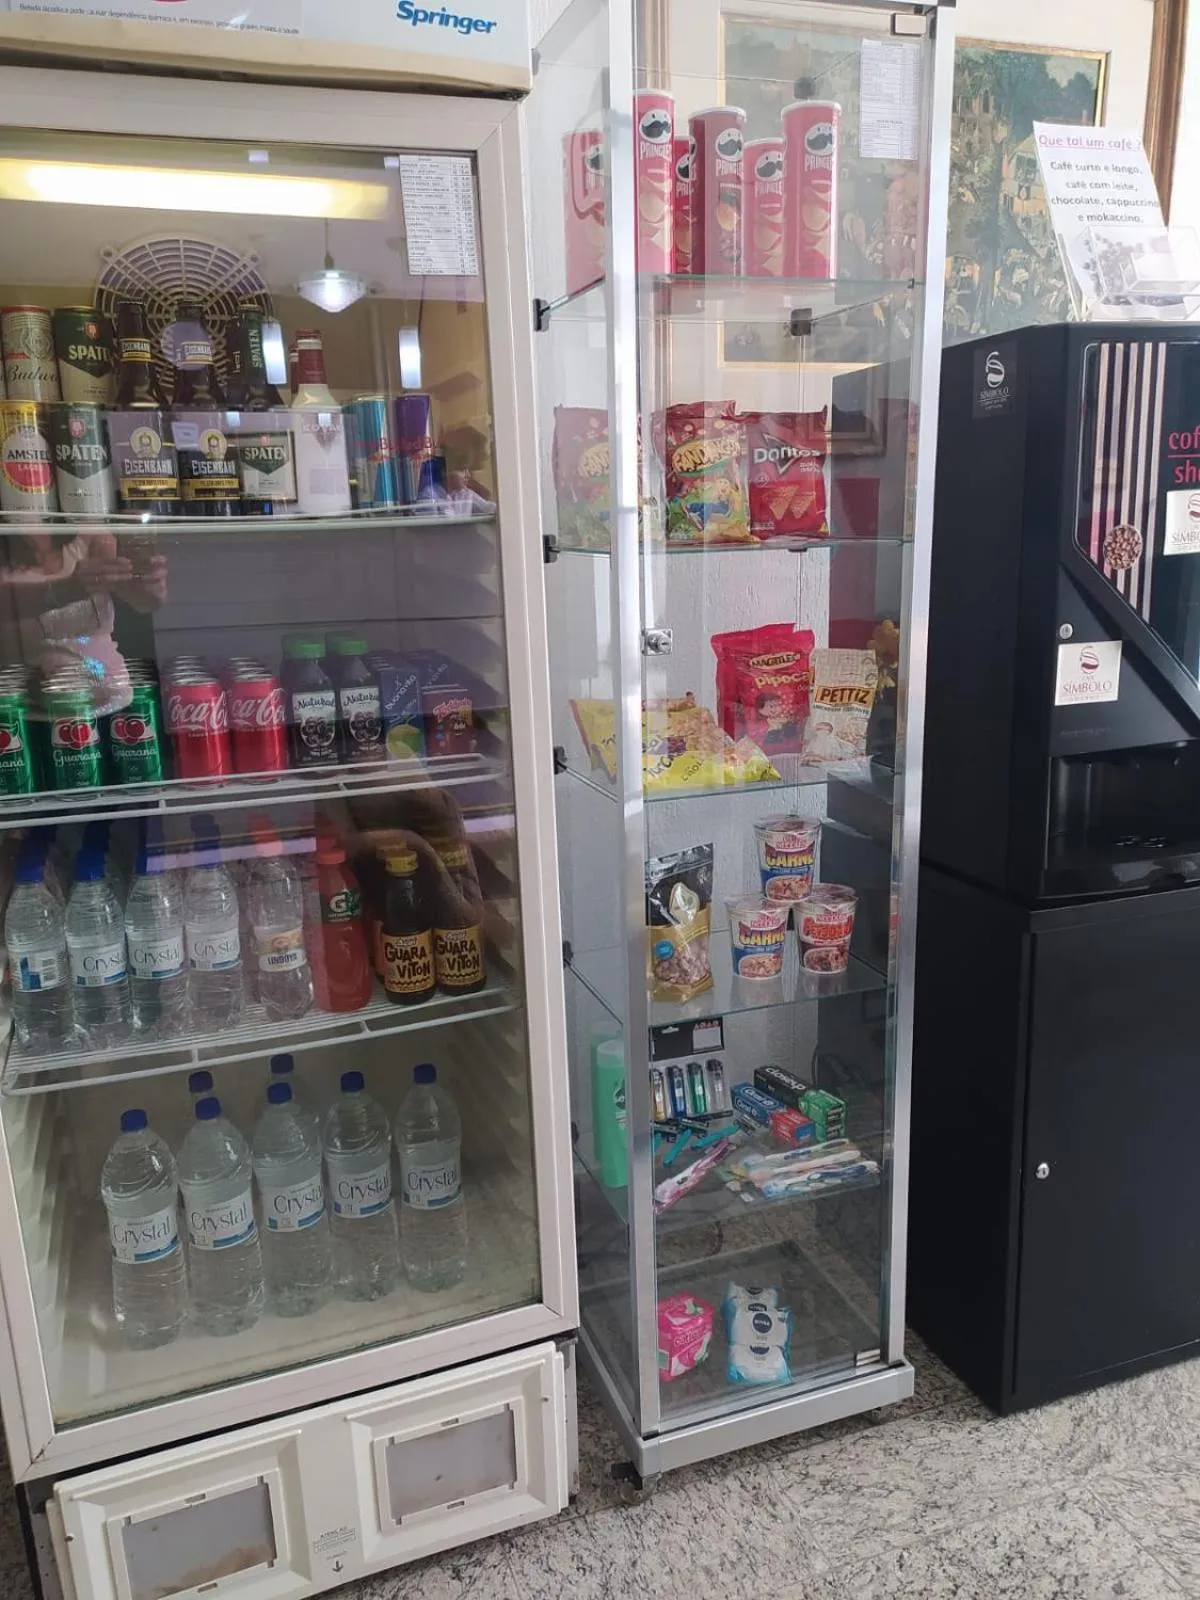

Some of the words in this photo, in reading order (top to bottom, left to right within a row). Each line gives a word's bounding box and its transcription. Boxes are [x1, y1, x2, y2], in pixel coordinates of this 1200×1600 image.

[396, 0, 497, 35] Springer
[1039, 134, 1063, 147] Que
[248, 328, 262, 368] SPATEN
[1168, 425, 1200, 450] cof
[754, 446, 821, 464] Doritos
[1174, 459, 1200, 484] sh
[820, 687, 871, 704] PETTIZ
[384, 941, 427, 963] GUARA
[435, 933, 477, 956] GUARA
[191, 1201, 248, 1232] Crystal
[113, 1215, 171, 1249] Crystal
